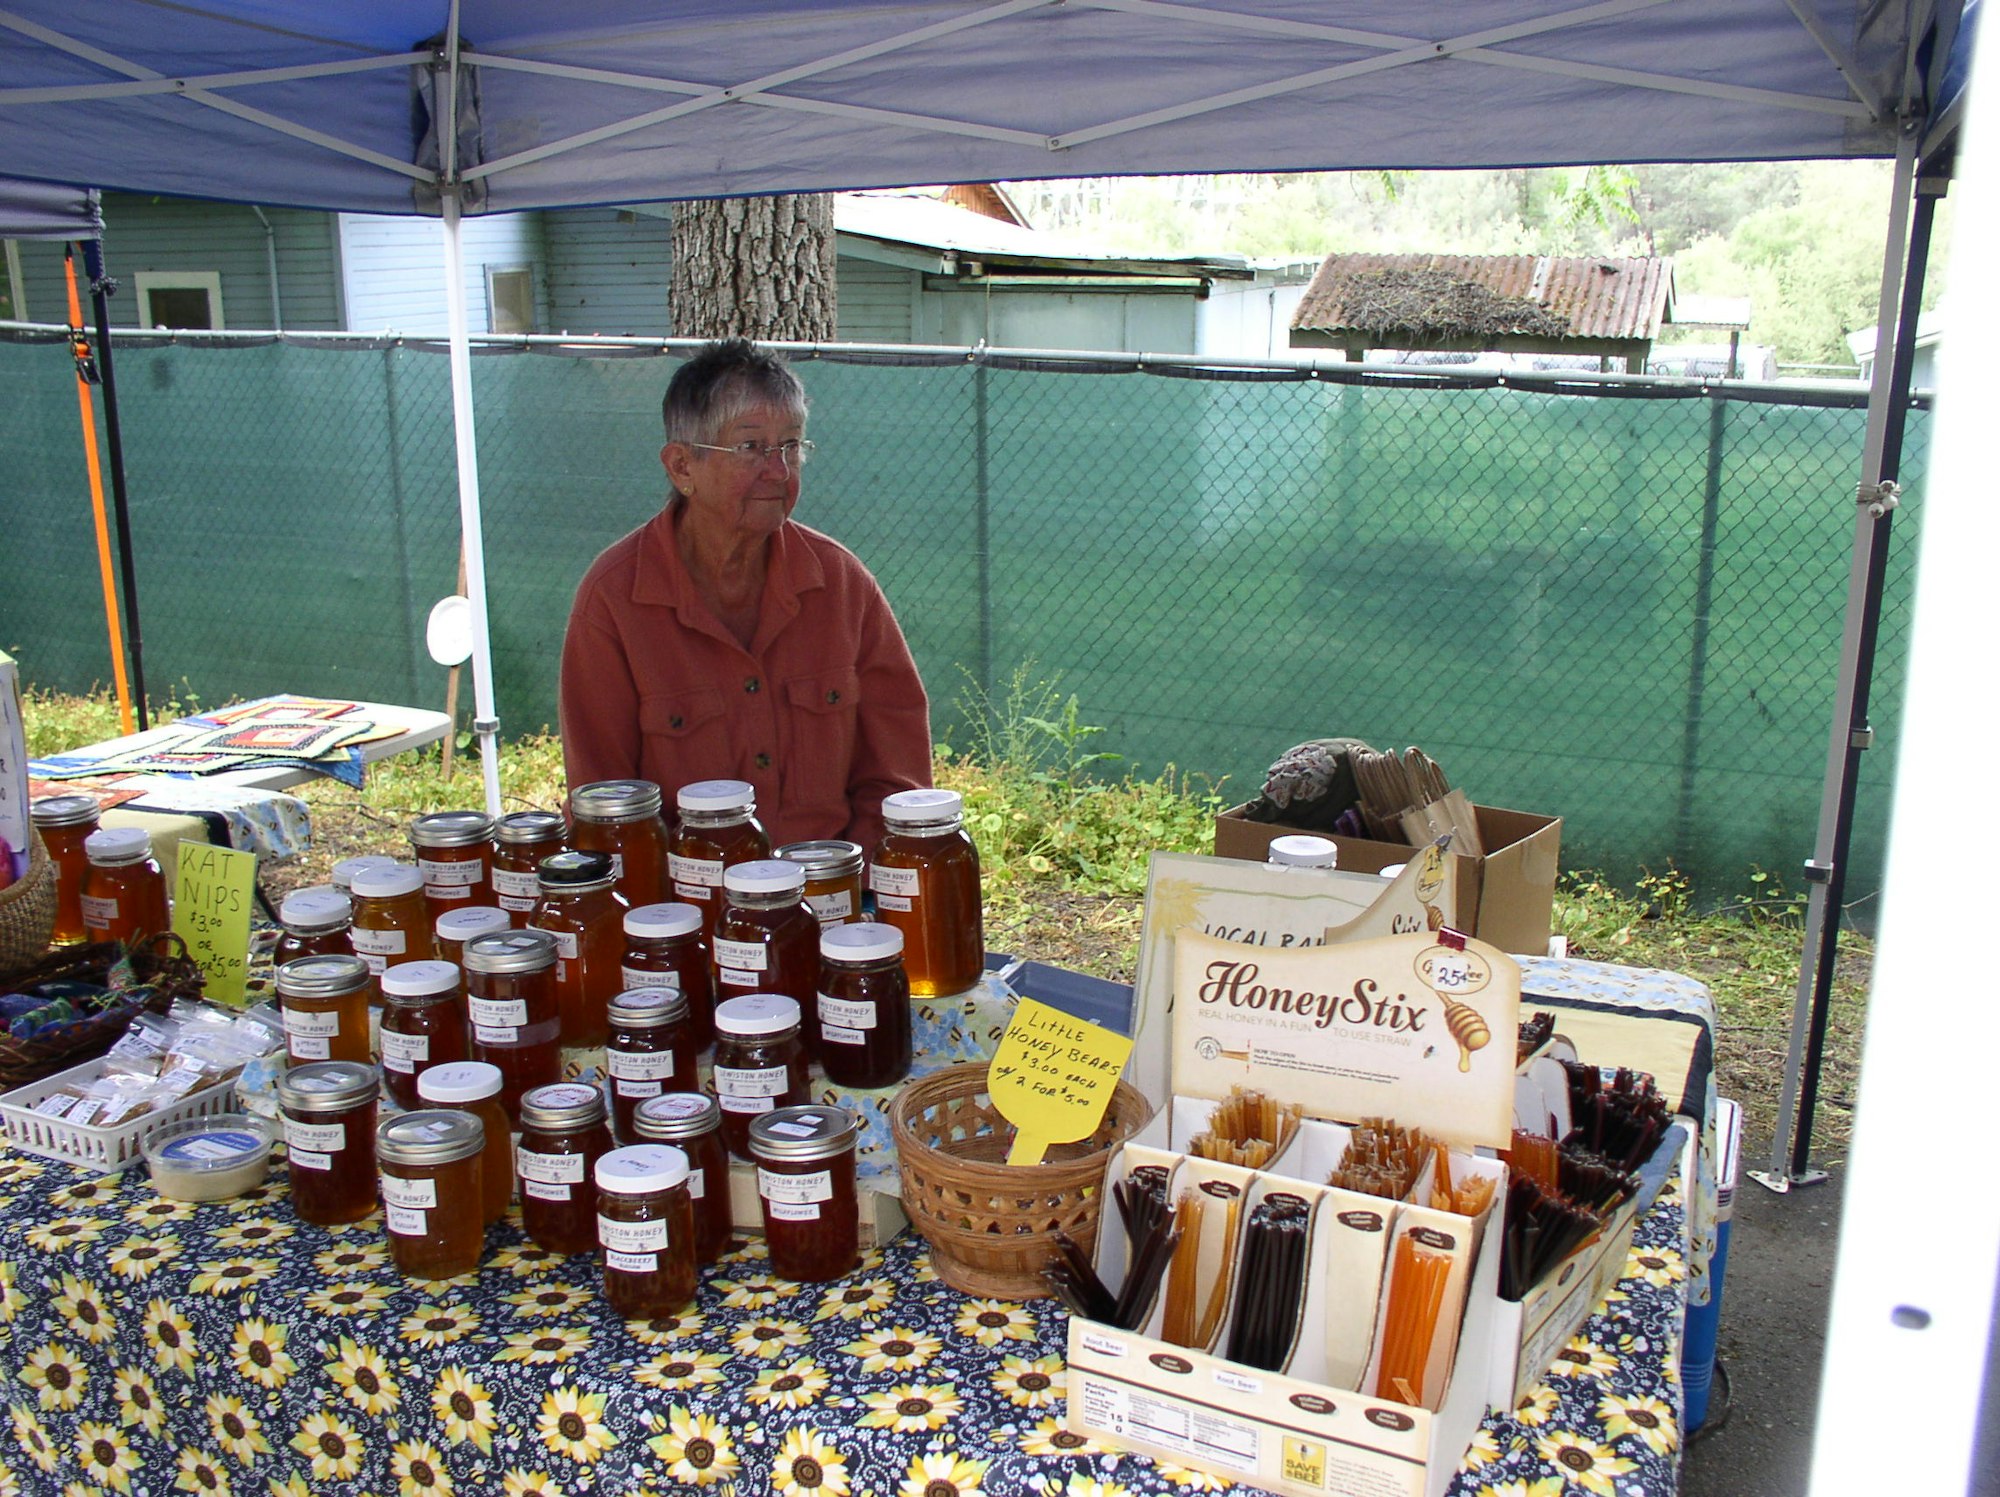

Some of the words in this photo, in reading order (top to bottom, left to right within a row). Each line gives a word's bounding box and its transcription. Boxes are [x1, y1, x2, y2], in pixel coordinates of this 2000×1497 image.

[182, 847, 234, 879] KAT
[696, 865, 722, 874] HONEY
[183, 878, 241, 914] NIPS
[1198, 960, 1428, 1034] HoneyStix
[843, 1006, 871, 1016] HONEY
[1198, 1010, 1223, 1023] REAL
[1225, 1014, 1263, 1028] HONEY
[1265, 1020, 1278, 1030] IN
[1279, 1021, 1289, 1031] A
[1291, 1023, 1313, 1034] FUN
[1333, 1029, 1349, 1042] TO
[1351, 1032, 1372, 1044] USE
[1374, 1034, 1414, 1051] STRAW
[402, 1036, 426, 1046] HONEY
[1007, 1026, 1063, 1061] HONEY
[1066, 1048, 1121, 1077] BEARS
[640, 1055, 668, 1065] HONEY
[757, 1071, 786, 1080] HONEY
[1064, 1073, 1097, 1090] EACH
[1031, 1082, 1058, 1097] FOR
[311, 1130, 340, 1139] HONEY
[549, 1158, 578, 1167] HONEY
[795, 1176, 825, 1186] HONEY
[403, 1194, 431, 1203] HONEY
[632, 1226, 665, 1238] HONEY
[1085, 1336, 1104, 1347] Root
[1216, 1374, 1235, 1386] Root
[1237, 1379, 1257, 1391] Beer
[1286, 1459, 1322, 1474] SAVE
[1294, 1470, 1321, 1485] BEE
